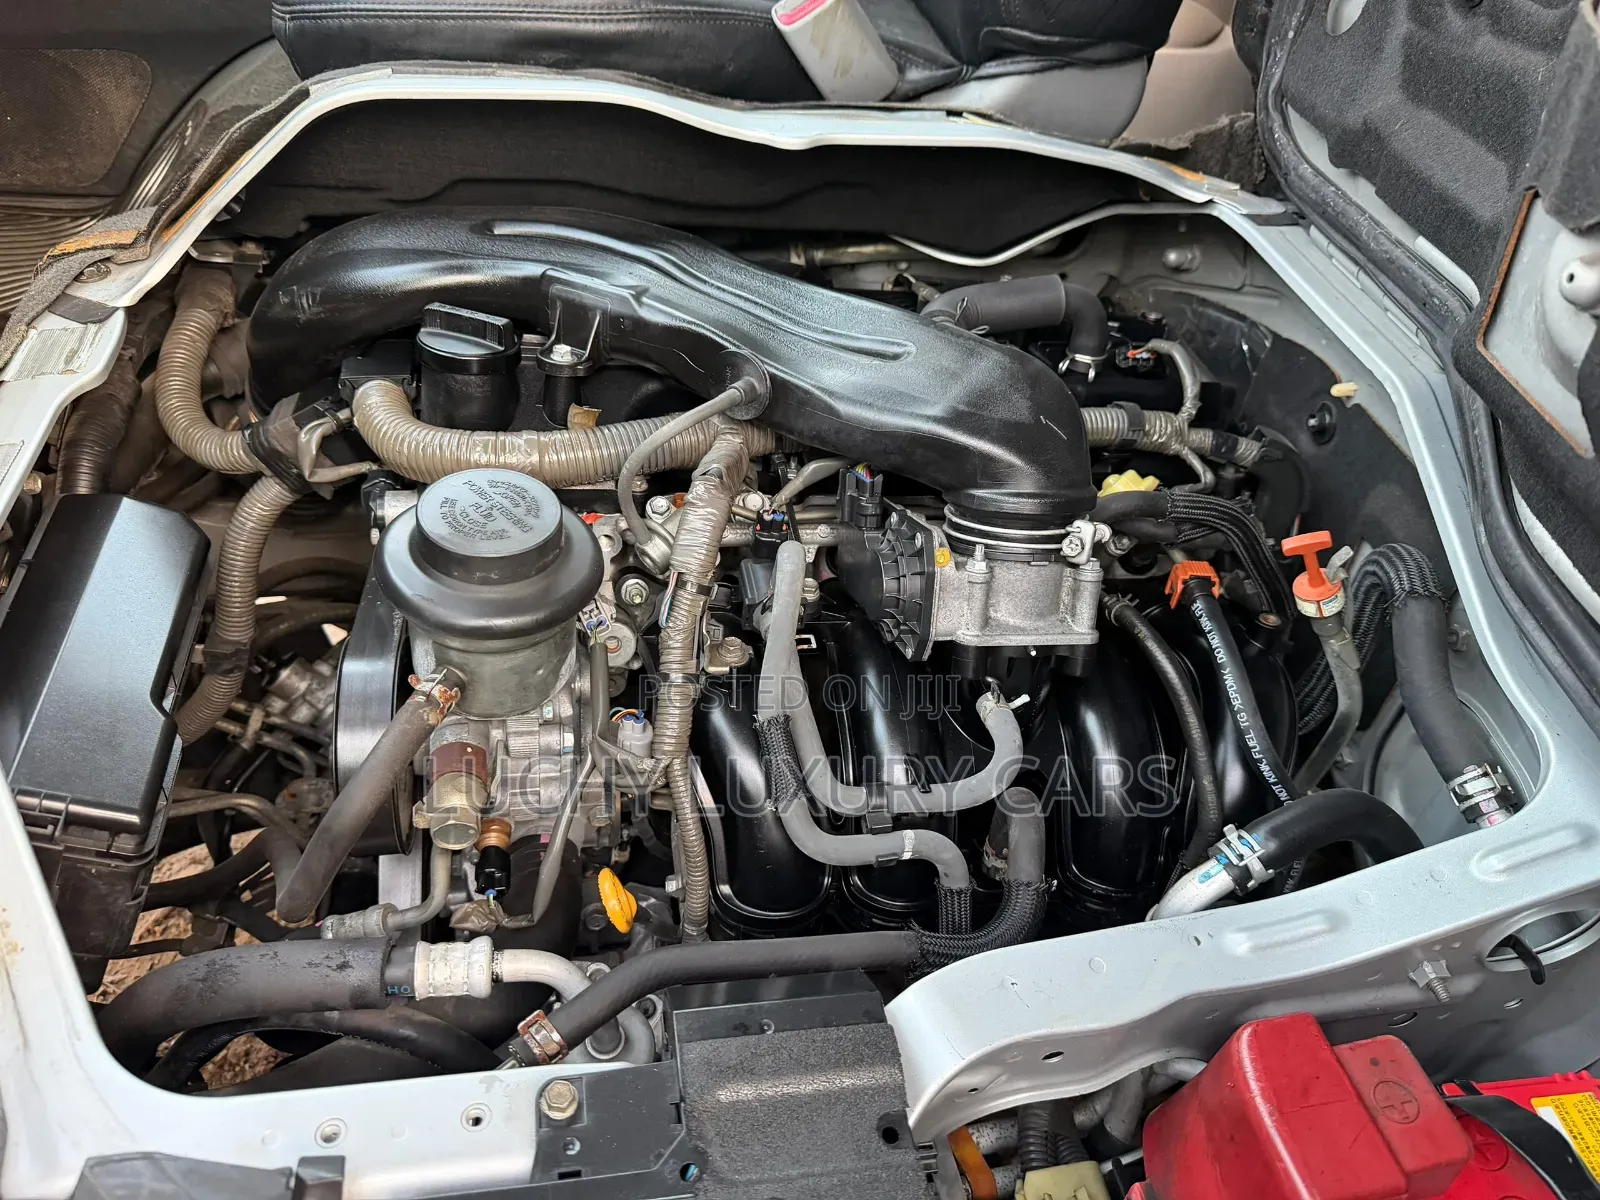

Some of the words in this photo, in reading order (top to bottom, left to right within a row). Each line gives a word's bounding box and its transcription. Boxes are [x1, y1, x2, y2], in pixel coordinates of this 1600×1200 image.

[462, 480, 495, 503] POWER
[491, 501, 533, 533] STEERING
[469, 502, 497, 522] FLUID
[459, 511, 489, 529] CLOSE
[1190, 600, 1203, 617] FUE
[1206, 631, 1221, 649] NOT
[1213, 648, 1227, 664] DO
[1237, 712, 1250, 729] TG
[1244, 729, 1264, 759] FUEL
[1271, 784, 1291, 801] NOT
